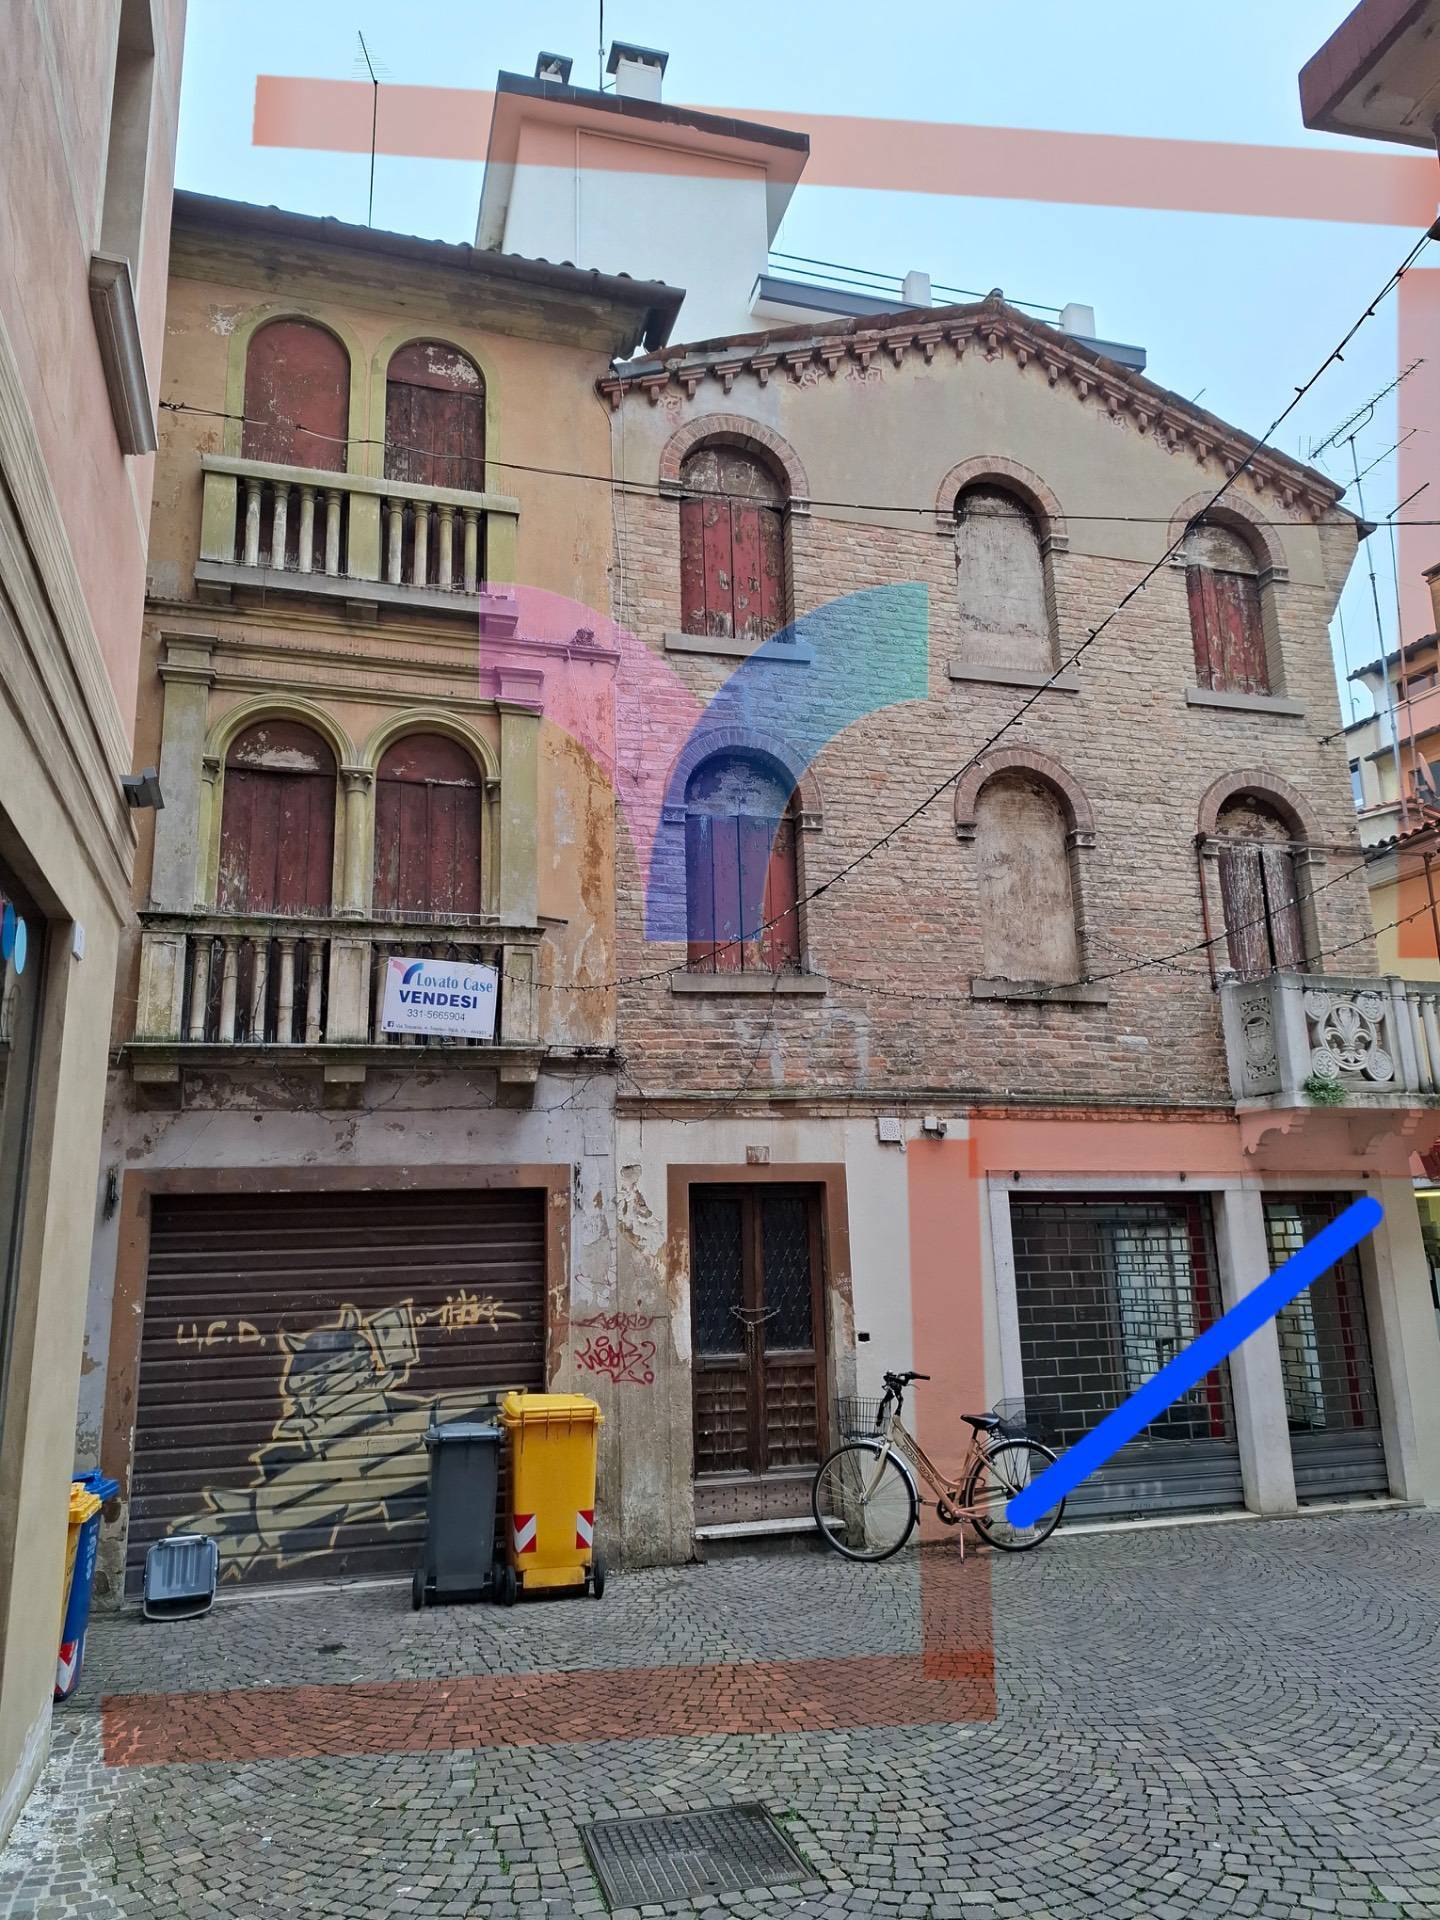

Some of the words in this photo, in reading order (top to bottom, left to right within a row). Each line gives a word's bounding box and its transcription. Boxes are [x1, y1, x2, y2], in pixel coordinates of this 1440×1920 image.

[417, 973, 458, 989] Lovato
[464, 977, 493, 993] Case
[399, 990, 477, 1009] VENDESI
